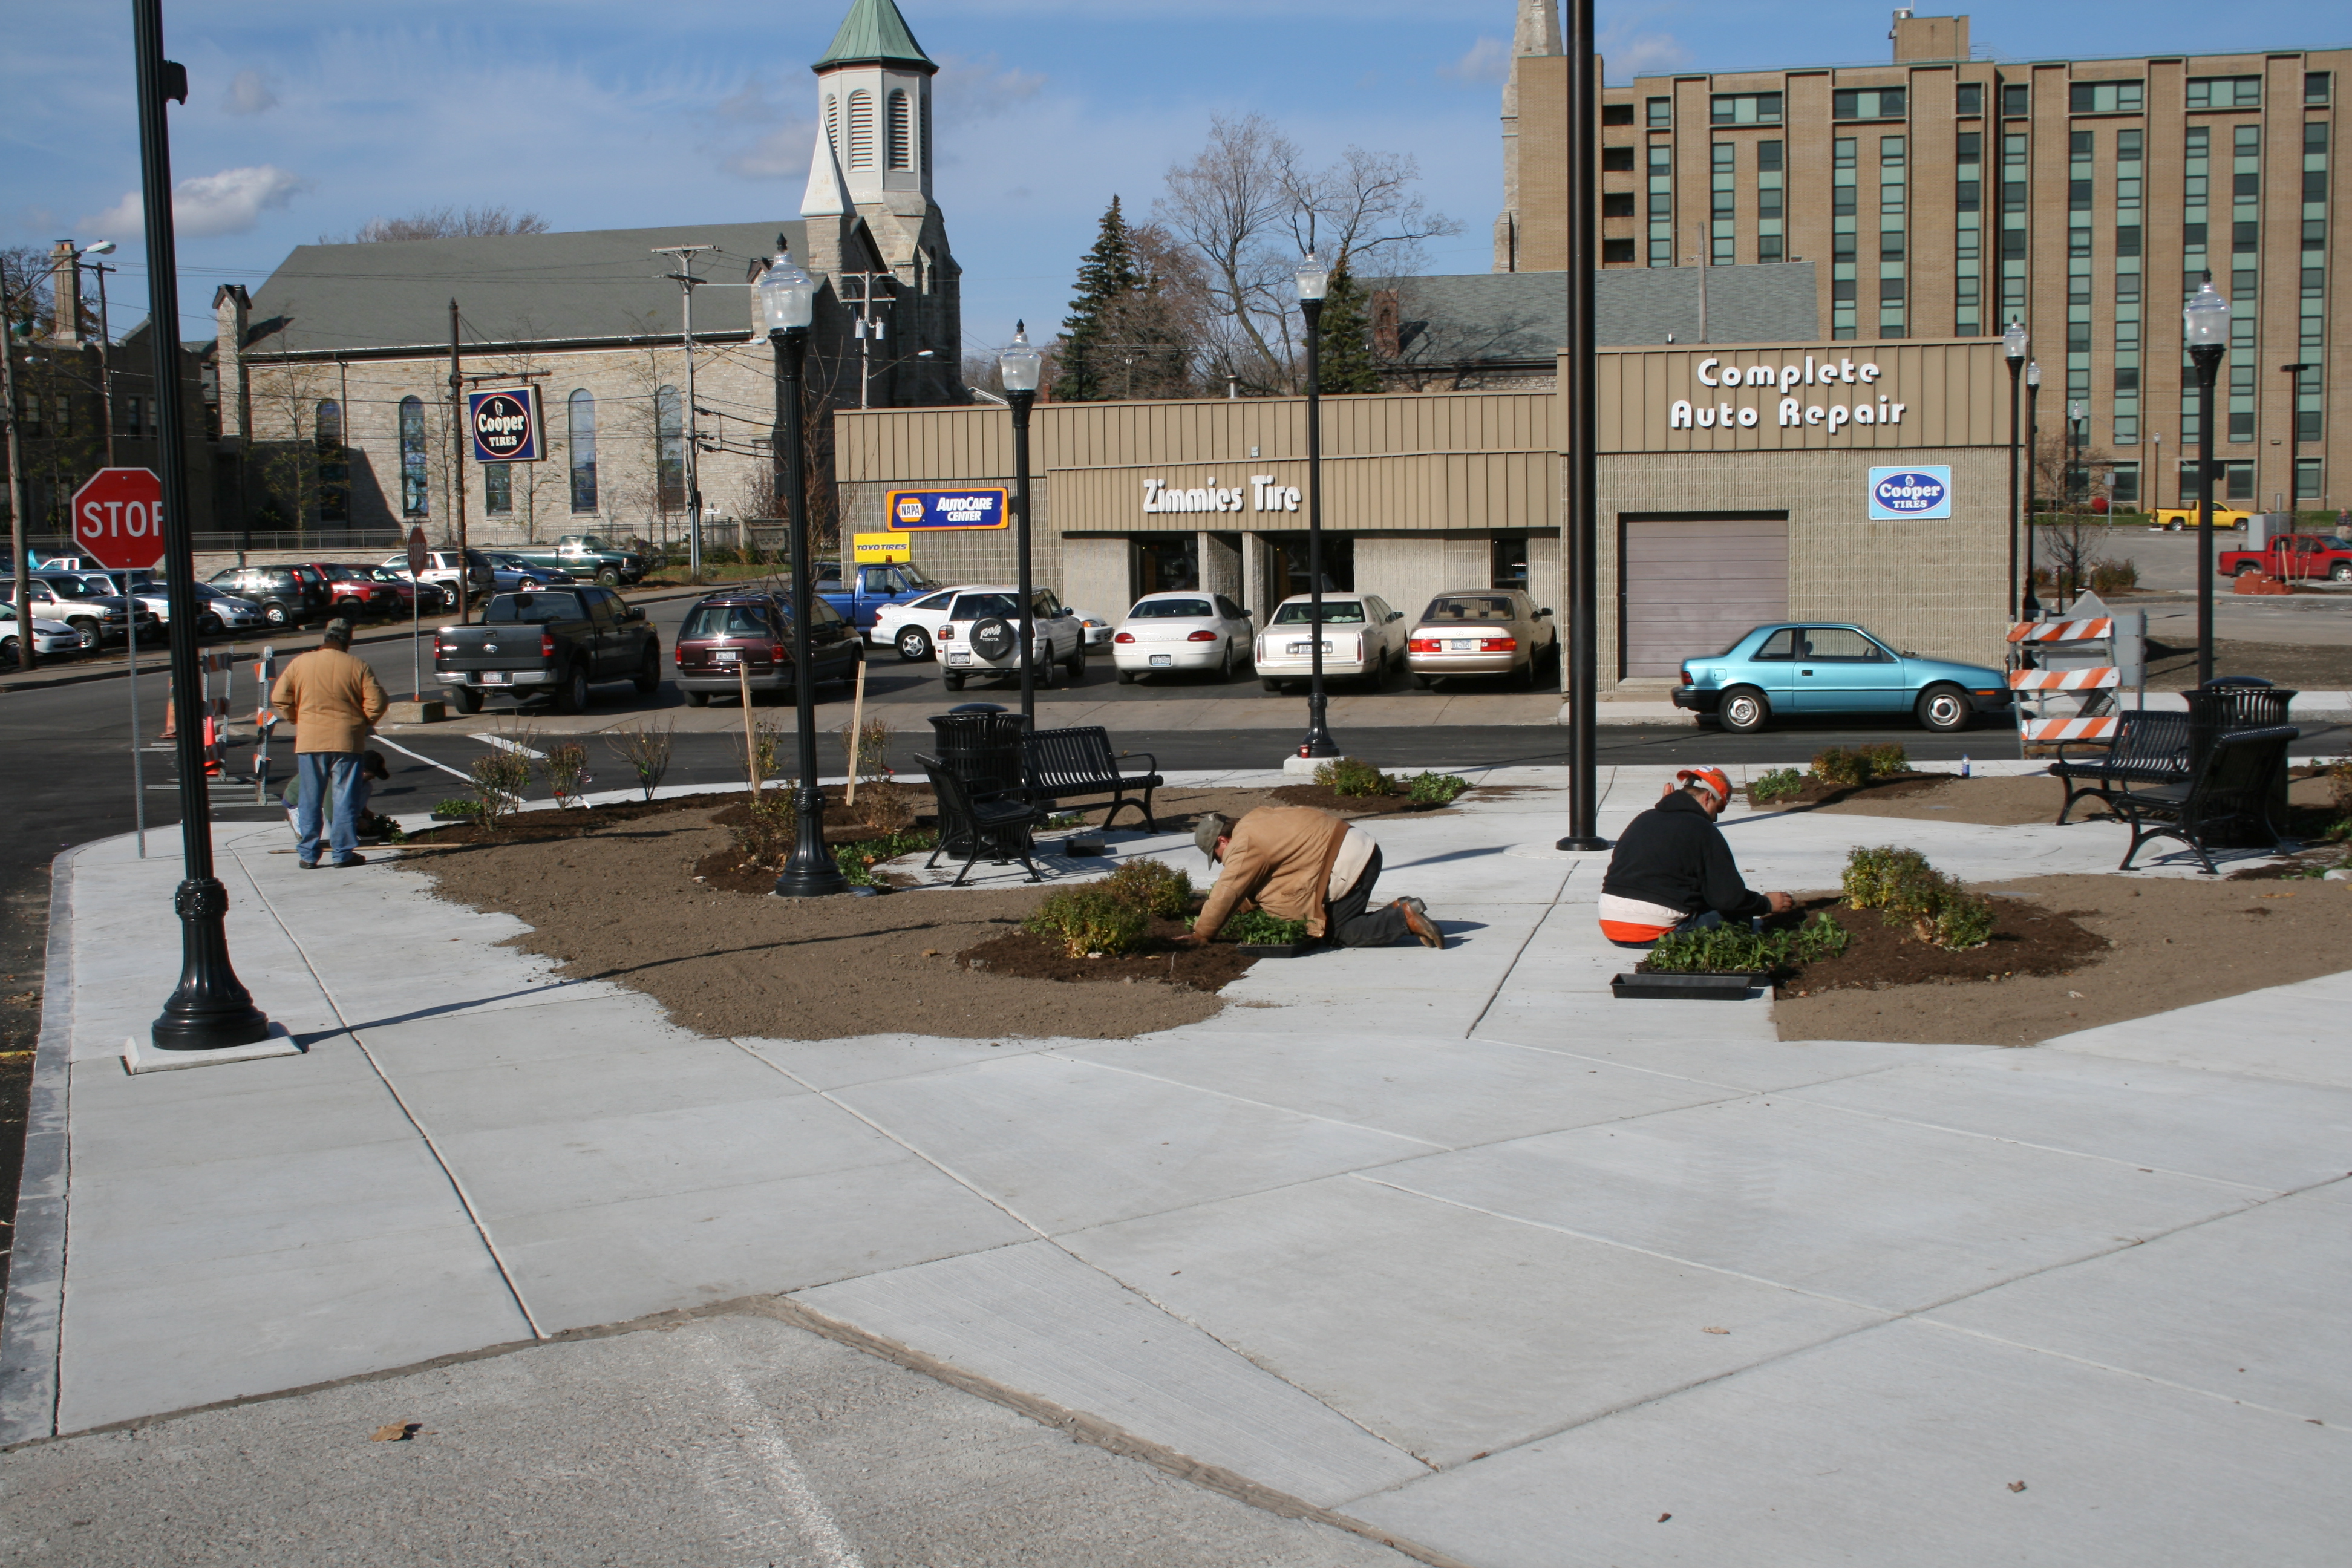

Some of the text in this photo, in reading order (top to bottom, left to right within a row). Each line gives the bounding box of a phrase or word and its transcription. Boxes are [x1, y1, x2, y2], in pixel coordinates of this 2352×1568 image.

[1697, 355, 1880, 393] Complete
[1671, 394, 1905, 433] Auto Repair
[478, 413, 524, 435] Cooper
[489, 436, 517, 447] TIRES
[1143, 474, 1301, 512] Zimmies Tire
[1879, 483, 1941, 500] Cooper
[901, 505, 920, 516] NAPA
[1892, 500, 1928, 508] TIRES
[947, 511, 982, 522] CENTER
[408, 543, 426, 561] STOP
